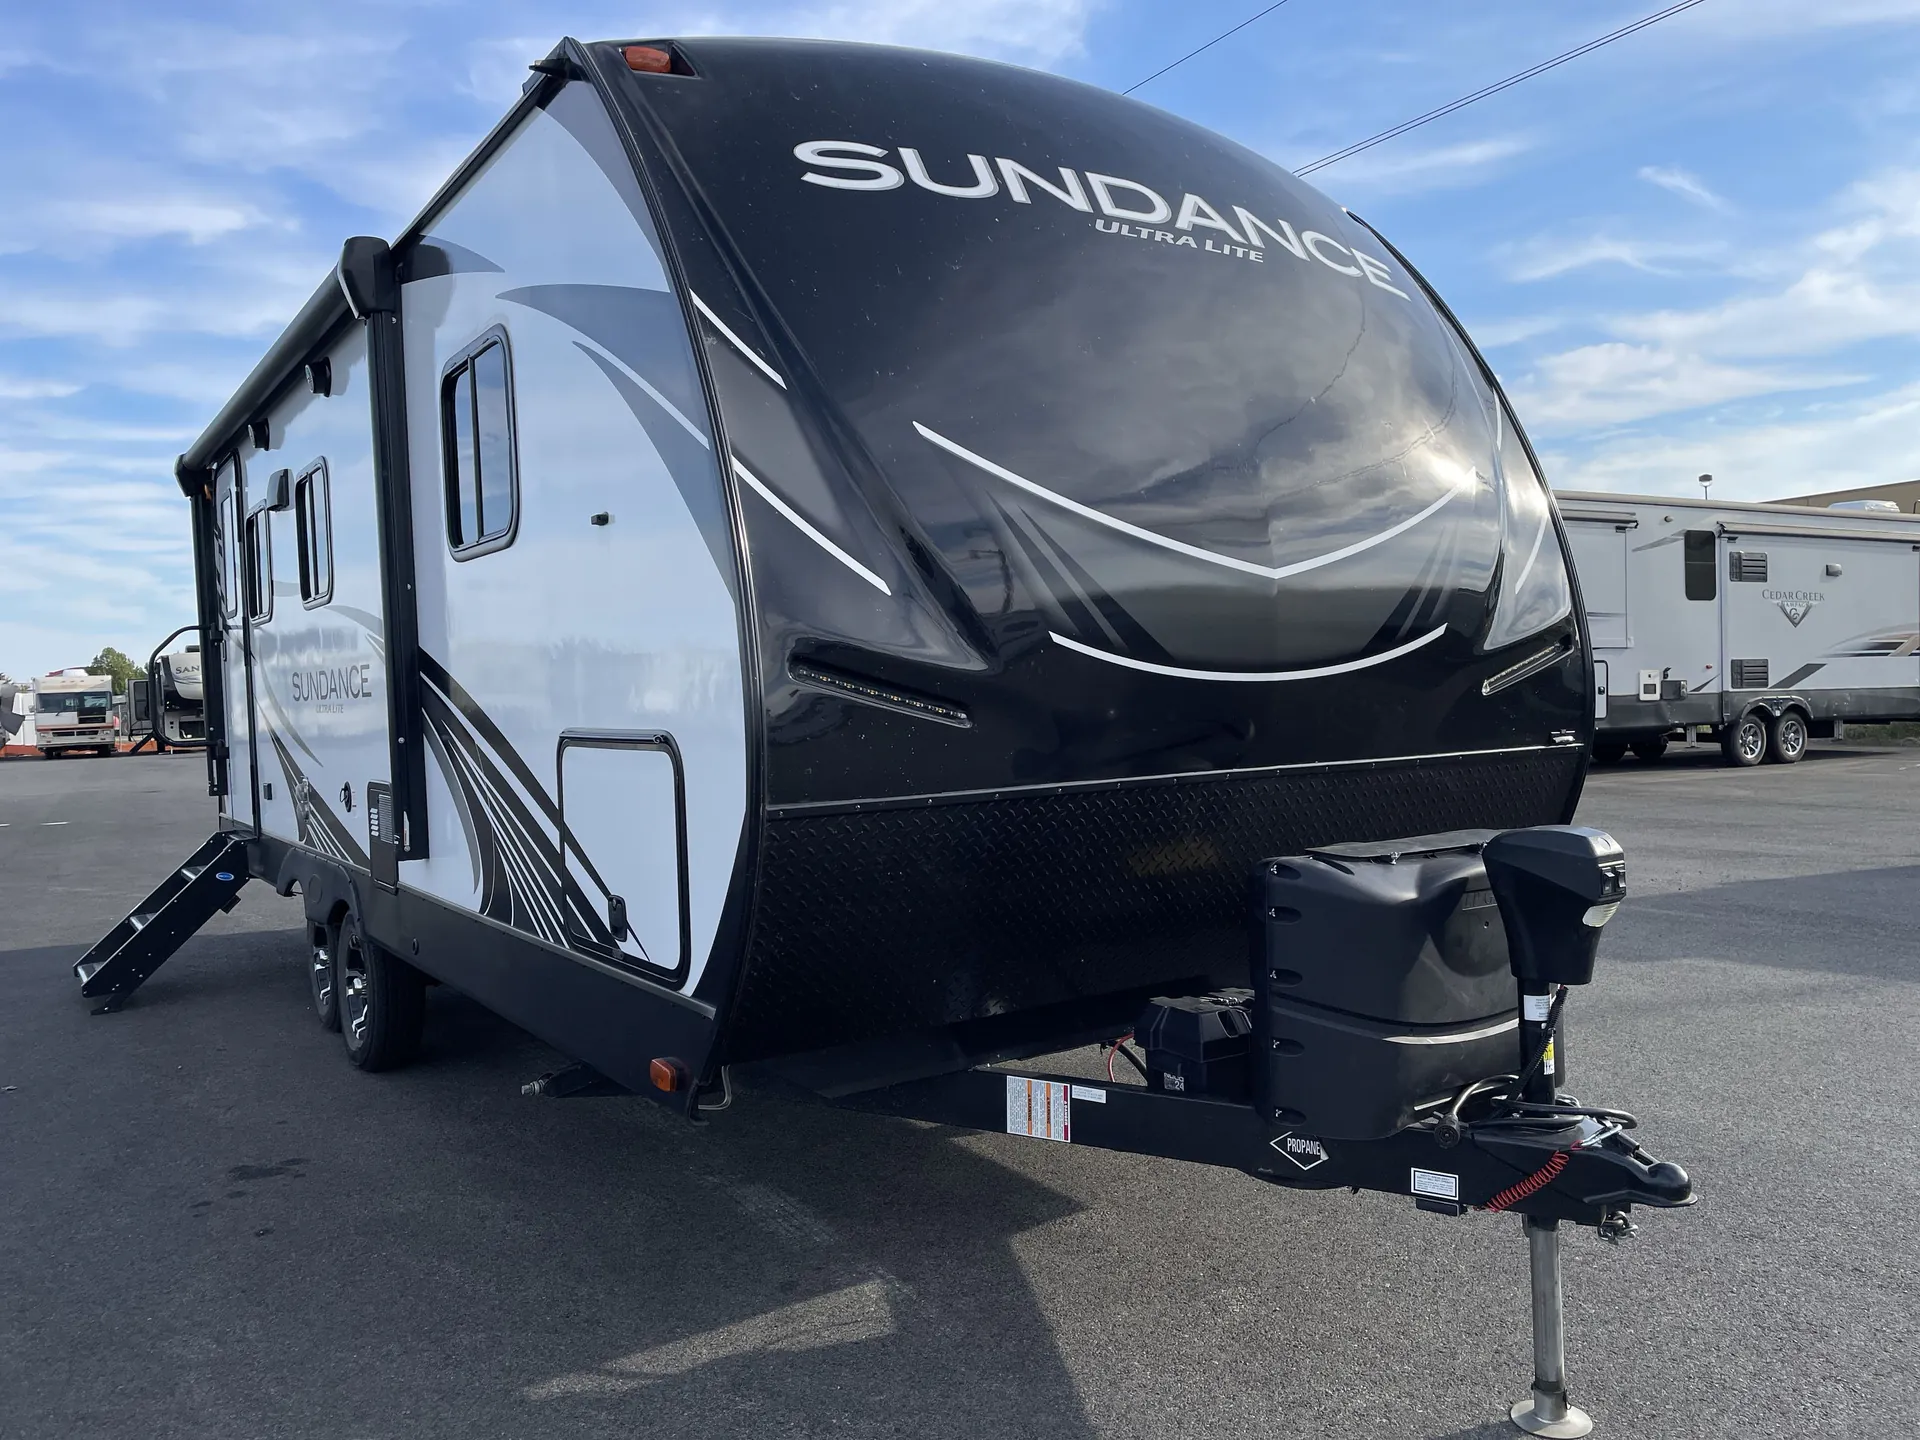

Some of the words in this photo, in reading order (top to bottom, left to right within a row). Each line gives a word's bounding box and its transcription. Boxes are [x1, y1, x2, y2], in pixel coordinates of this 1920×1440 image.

[793, 139, 1412, 301] SUNDANCE
[1095, 218, 1198, 249] ULTRA
[1204, 240, 1264, 264] LITE
[1762, 589, 1794, 600] CEDAR
[1795, 590, 1825, 602] CREEK
[292, 664, 372, 702] SUNDANCE
[315, 703, 331, 714] ULTRA
[332, 701, 344, 714] LITE
[1287, 1138, 1321, 1155] PROPANE
